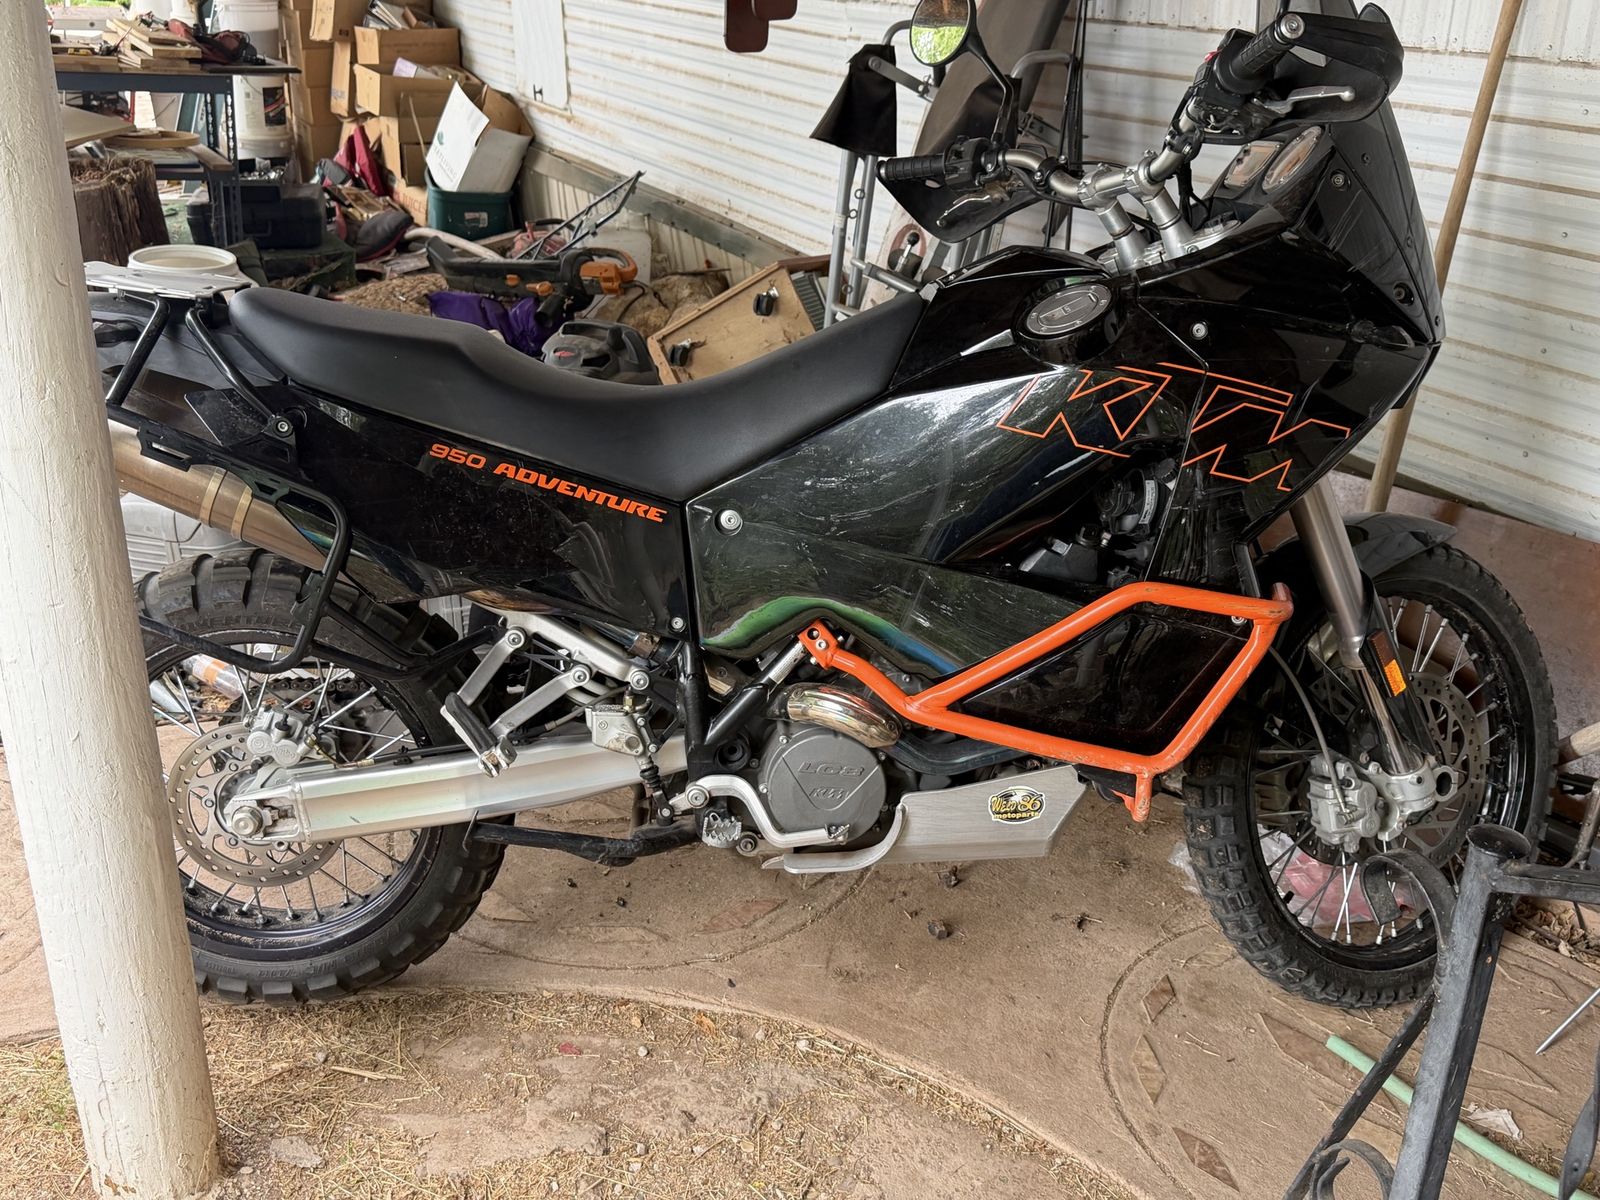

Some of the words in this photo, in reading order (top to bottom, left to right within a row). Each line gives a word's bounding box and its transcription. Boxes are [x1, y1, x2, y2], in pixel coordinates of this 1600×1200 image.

[996, 361, 1352, 493] KTM
[429, 443, 487, 469] 950
[493, 462, 668, 523] ADVENTURE
[1018, 794, 1043, 812] 86
